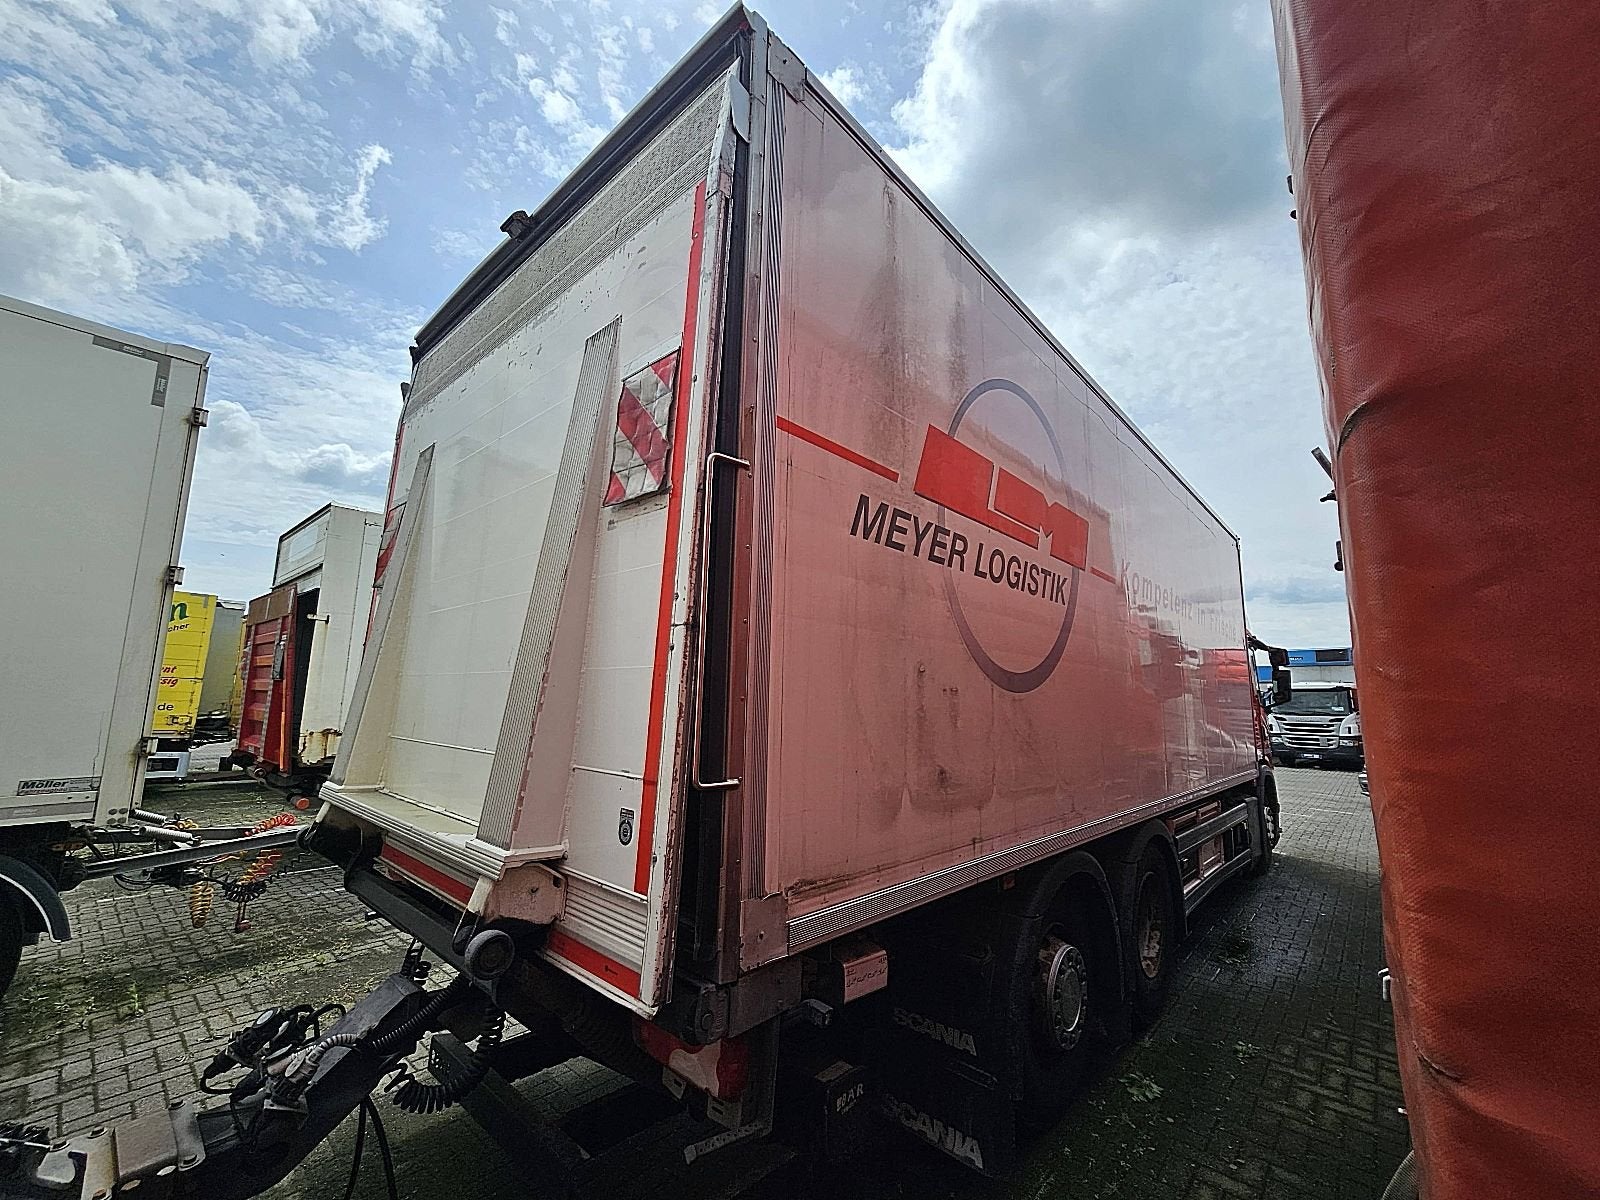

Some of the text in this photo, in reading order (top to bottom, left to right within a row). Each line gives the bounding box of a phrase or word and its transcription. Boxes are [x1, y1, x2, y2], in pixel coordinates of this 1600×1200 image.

[850, 494, 1067, 605] MEYER LOGISTIK
[1121, 559, 1192, 620] Kompetenz
[21, 780, 69, 789] Möller
[893, 1007, 977, 1057] SCANIA
[880, 1094, 983, 1169] SCANIA
